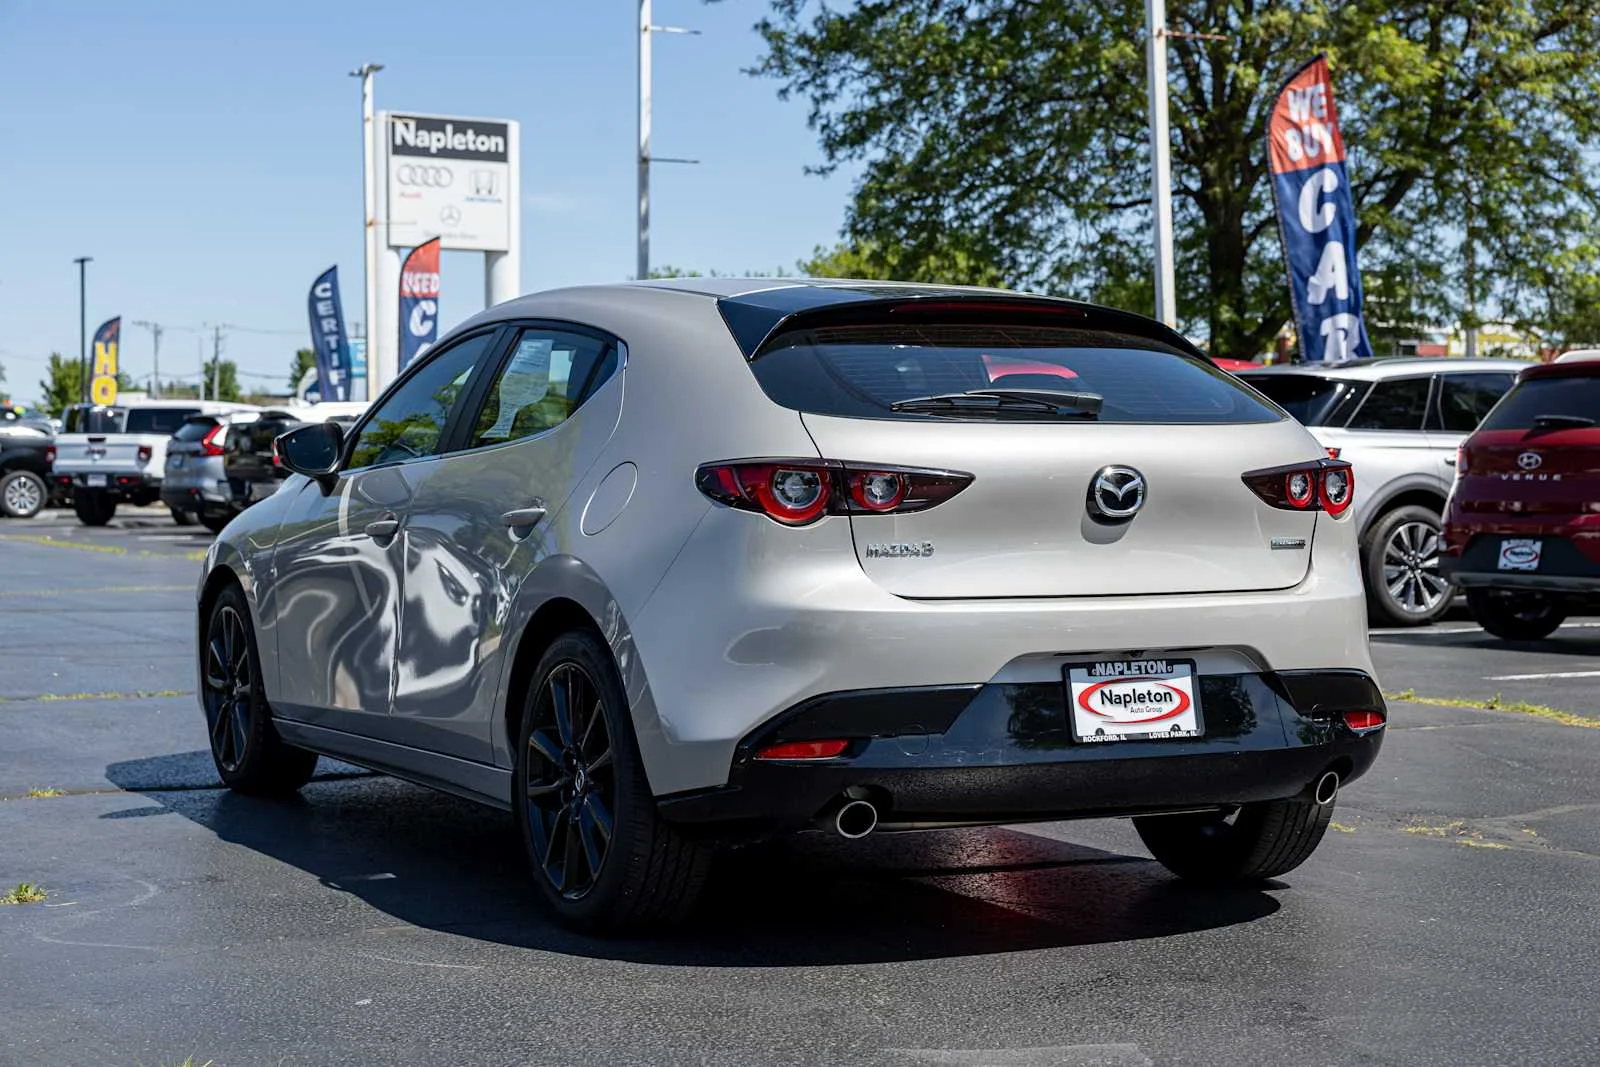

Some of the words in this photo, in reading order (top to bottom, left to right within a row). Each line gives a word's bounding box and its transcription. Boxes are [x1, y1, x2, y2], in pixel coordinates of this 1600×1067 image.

[1286, 83, 1327, 122] WE
[394, 120, 505, 154] Napleton
[1285, 121, 1333, 161] BUY
[1501, 473, 1562, 481] VENUE
[1096, 660, 1167, 676] NAPLETON
[1100, 688, 1173, 709] Napleton
[1146, 705, 1163, 714] Group
[1120, 733, 1127, 741] IL
